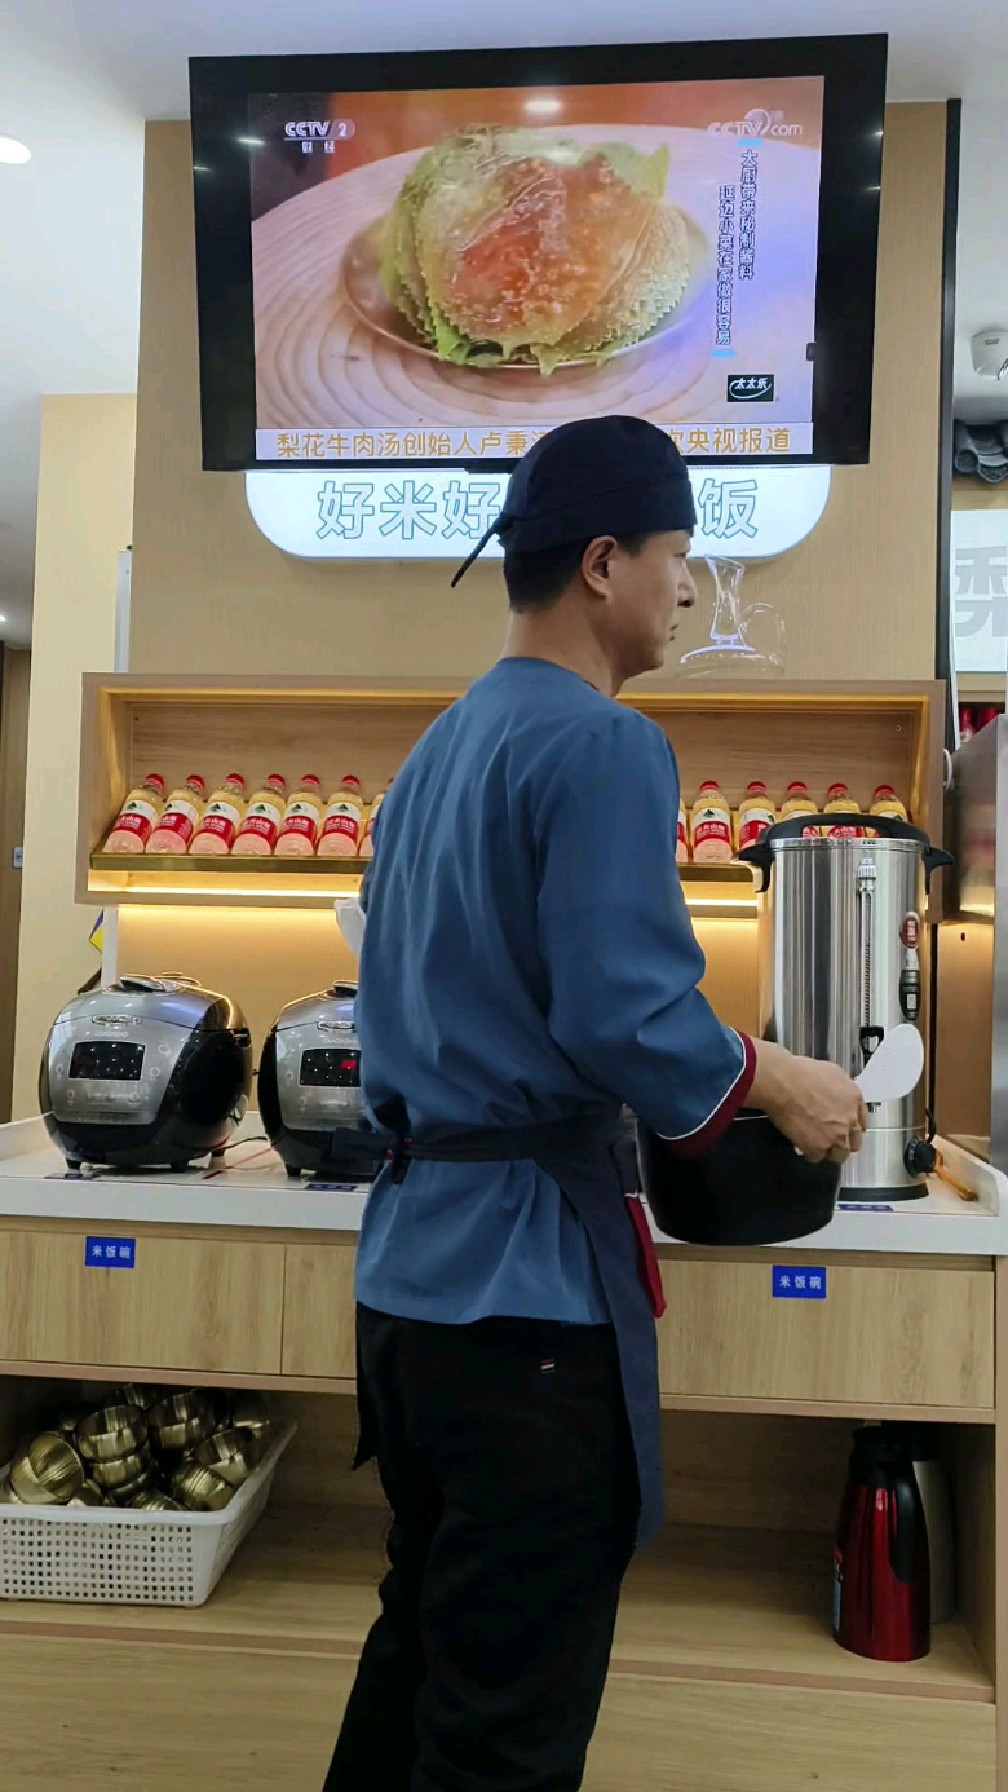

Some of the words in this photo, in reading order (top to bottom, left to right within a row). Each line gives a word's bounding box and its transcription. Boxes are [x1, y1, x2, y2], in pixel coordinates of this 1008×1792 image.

[285, 121, 330, 137] CCTV
[338, 122, 348, 137] 2
[778, 1274, 822, 1290] 米饭碗
